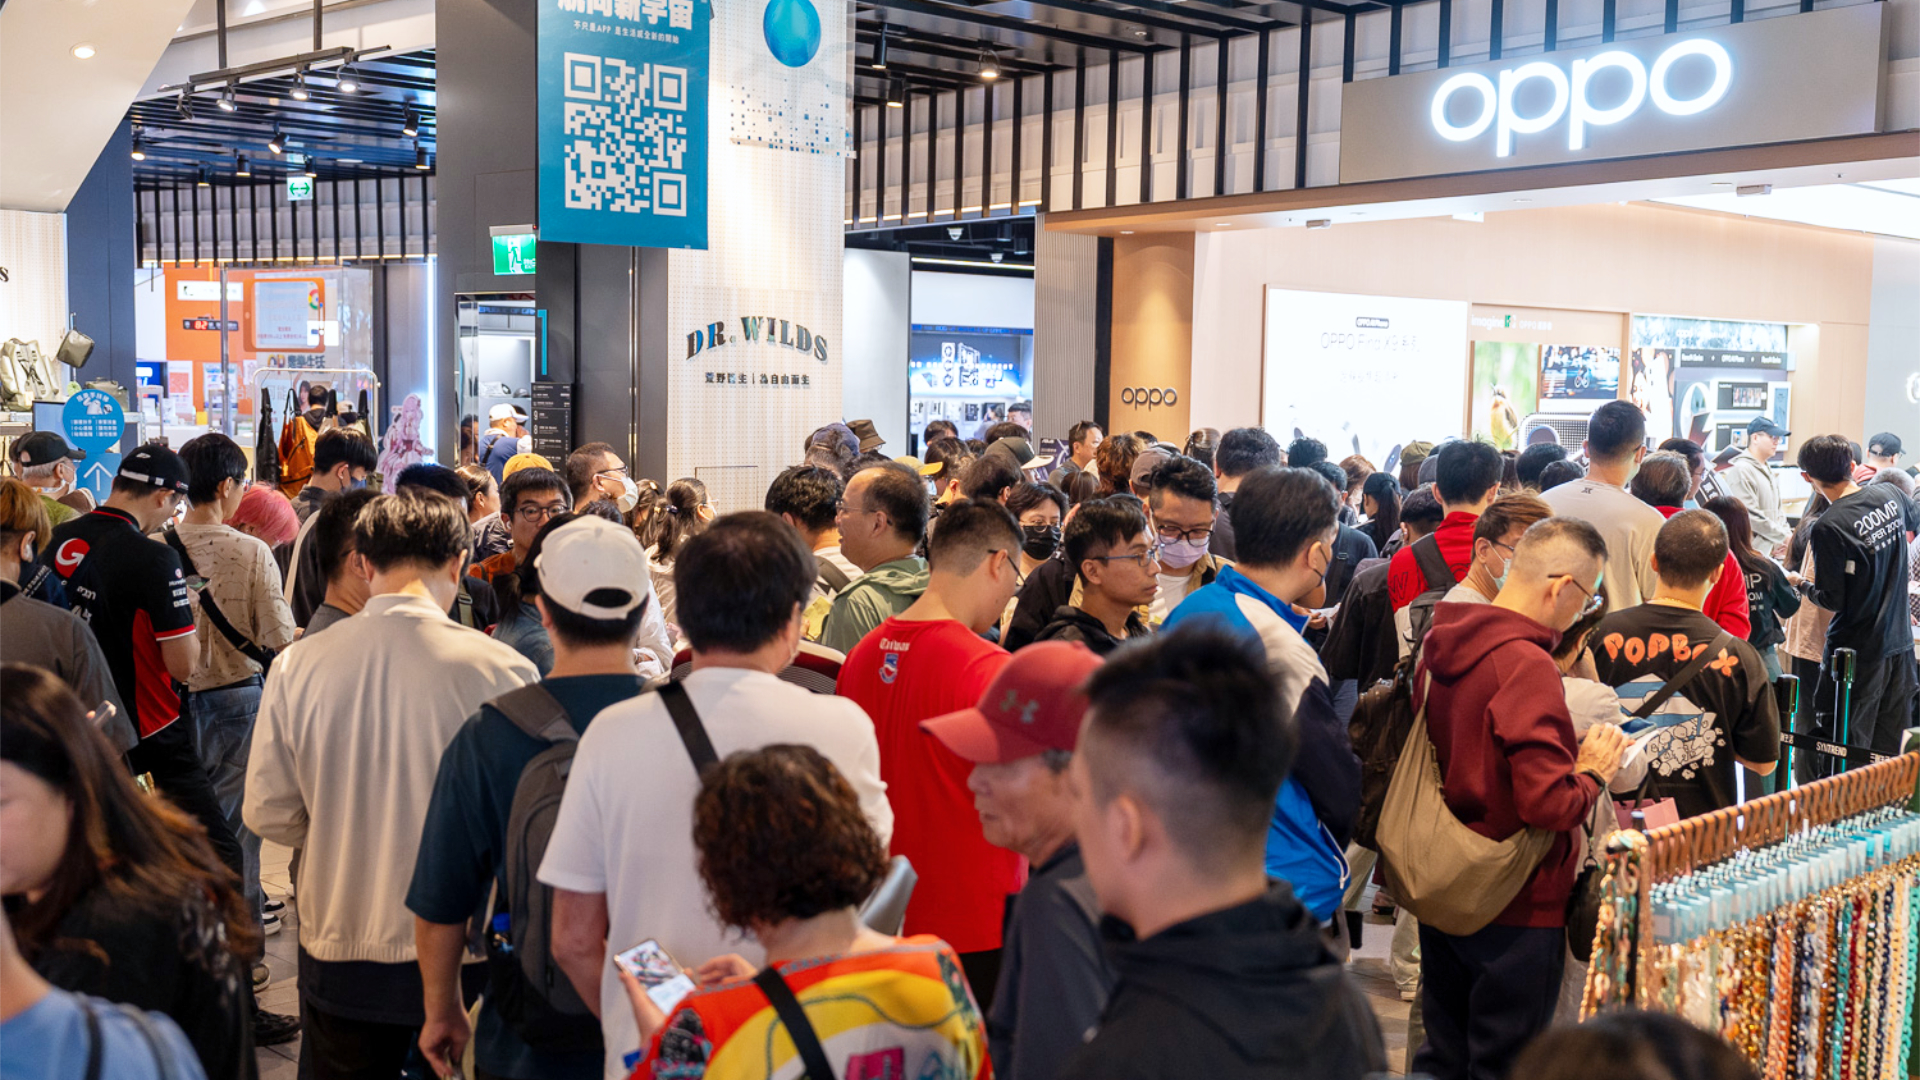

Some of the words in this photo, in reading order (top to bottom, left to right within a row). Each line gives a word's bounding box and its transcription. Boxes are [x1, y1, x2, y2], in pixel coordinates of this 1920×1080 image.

[1431, 38, 1733, 158] oppo
[686, 321, 737, 360] DR.
[740, 316, 829, 362] WILDS
[1320, 332, 1355, 350] OPPO
[1121, 387, 1177, 411] oppo
[1853, 500, 1899, 537] 200MP
[1816, 741, 1848, 757] SYNTREND
